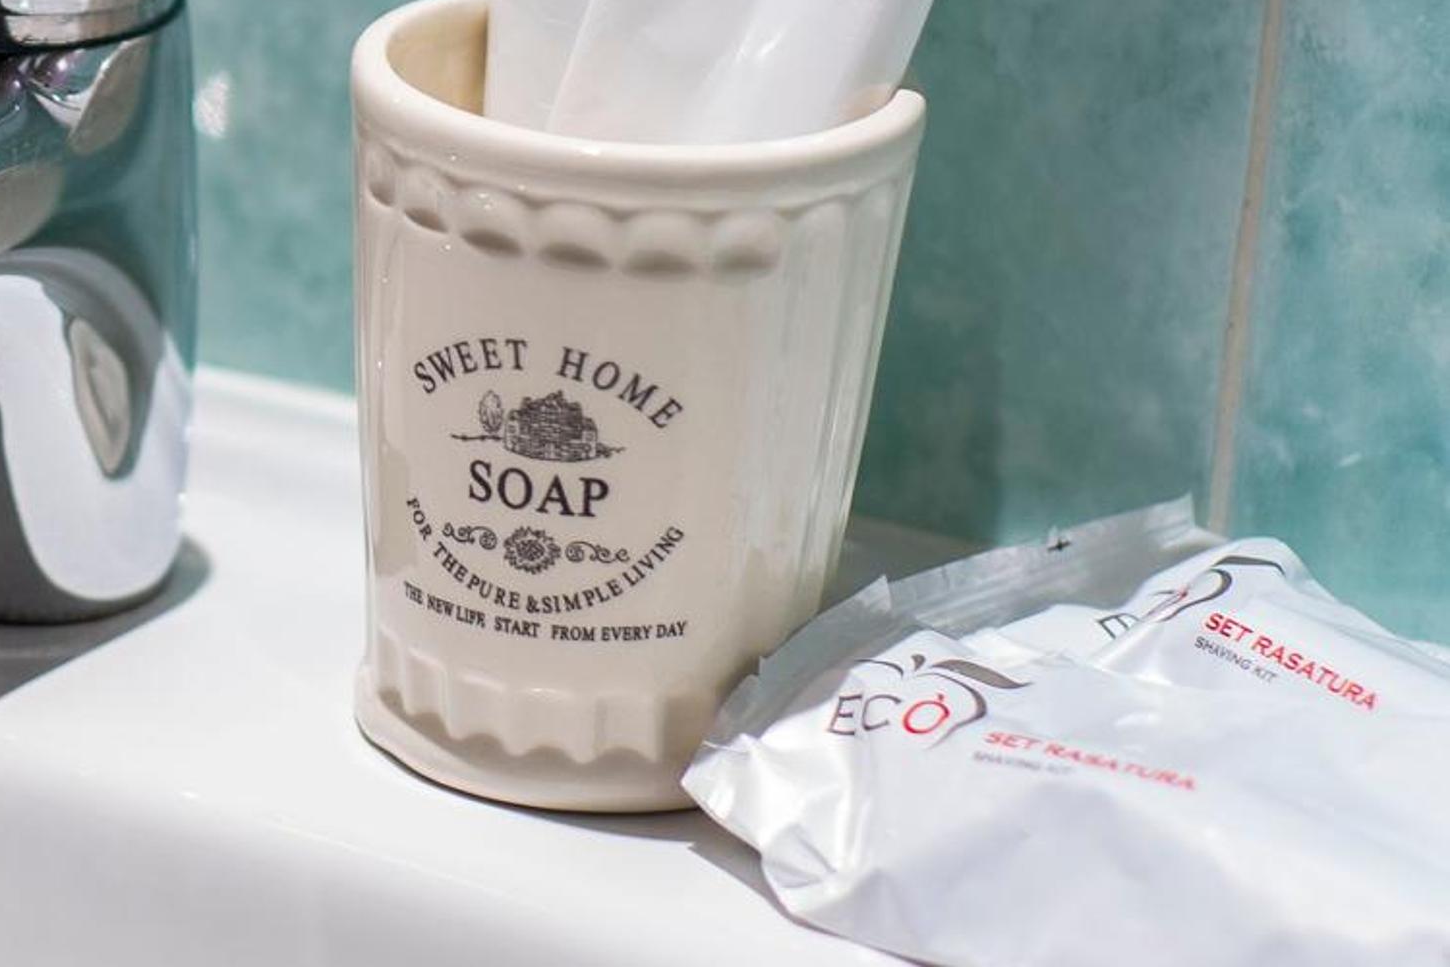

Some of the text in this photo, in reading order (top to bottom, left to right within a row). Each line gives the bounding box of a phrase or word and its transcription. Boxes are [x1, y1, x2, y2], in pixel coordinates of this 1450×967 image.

[414, 338, 684, 429] SWEET HOME
[469, 460, 609, 517] SOAP
[406, 498, 432, 541] FOR
[433, 541, 469, 583] THE
[467, 574, 520, 610] PURE
[622, 526, 684, 587] LIVING
[403, 580, 423, 605] THE
[427, 593, 455, 617] NEW
[493, 616, 540, 638] START
[551, 624, 596, 642] FROM
[600, 625, 653, 642] EVERY
[655, 620, 688, 639] DAY
[1194, 636, 1278, 684] SHAVING KIT
[1205, 612, 1253, 643] SET
[1251, 635, 1378, 711] RASATURA
[984, 732, 1196, 790] SET RASATURA
